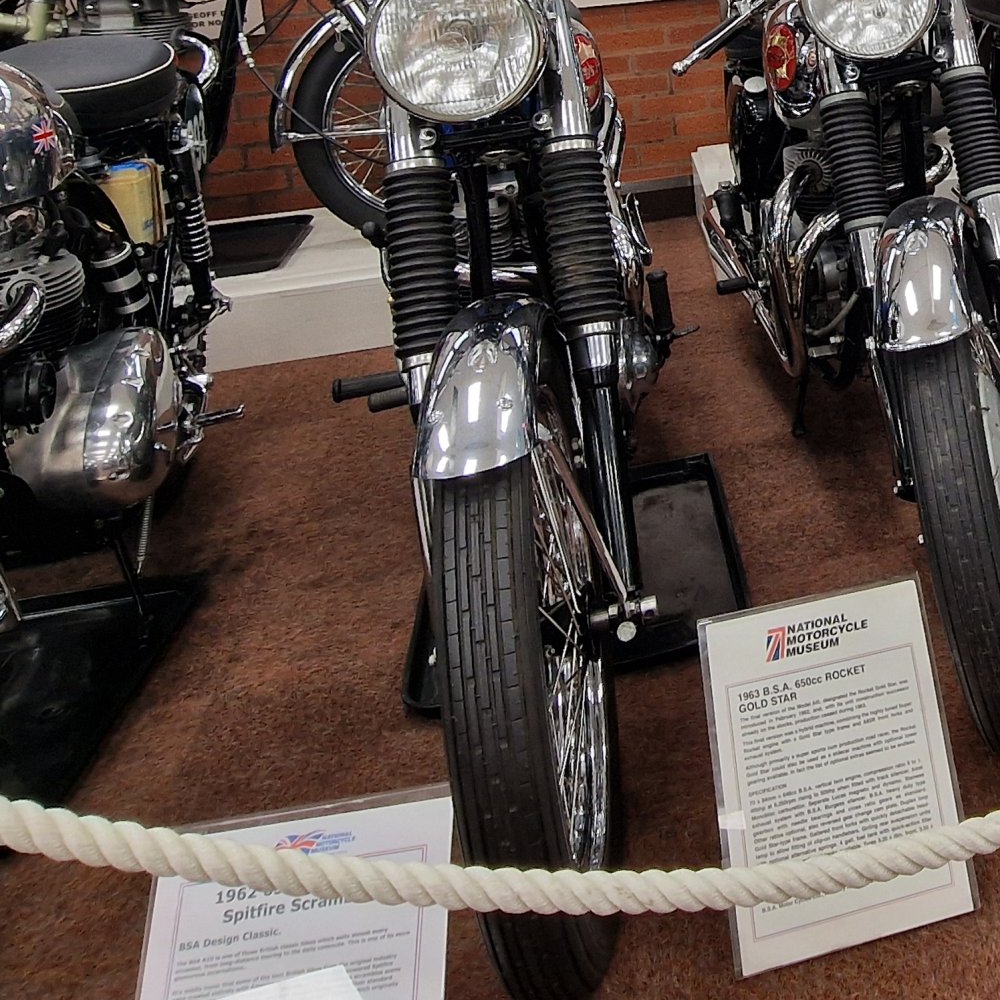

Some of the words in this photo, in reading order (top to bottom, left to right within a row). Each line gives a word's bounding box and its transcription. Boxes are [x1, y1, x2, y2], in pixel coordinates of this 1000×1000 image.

[786, 619, 868, 646] MOTORCYCLE
[787, 613, 848, 634] NATIONAL
[786, 637, 840, 658] MUSEUM
[737, 687, 760, 702] 1963
[762, 680, 792, 696] B.S.A.
[794, 673, 822, 689] 650cc
[824, 663, 866, 682] ROCKET
[738, 697, 768, 714] GOLD
[770, 691, 797, 706] STAR
[215, 887, 257, 905] 1962
[222, 902, 285, 924] Spitfire
[179, 940, 200, 952] BSA
[203, 934, 240, 948] Design
[243, 927, 282, 941] Classic.
